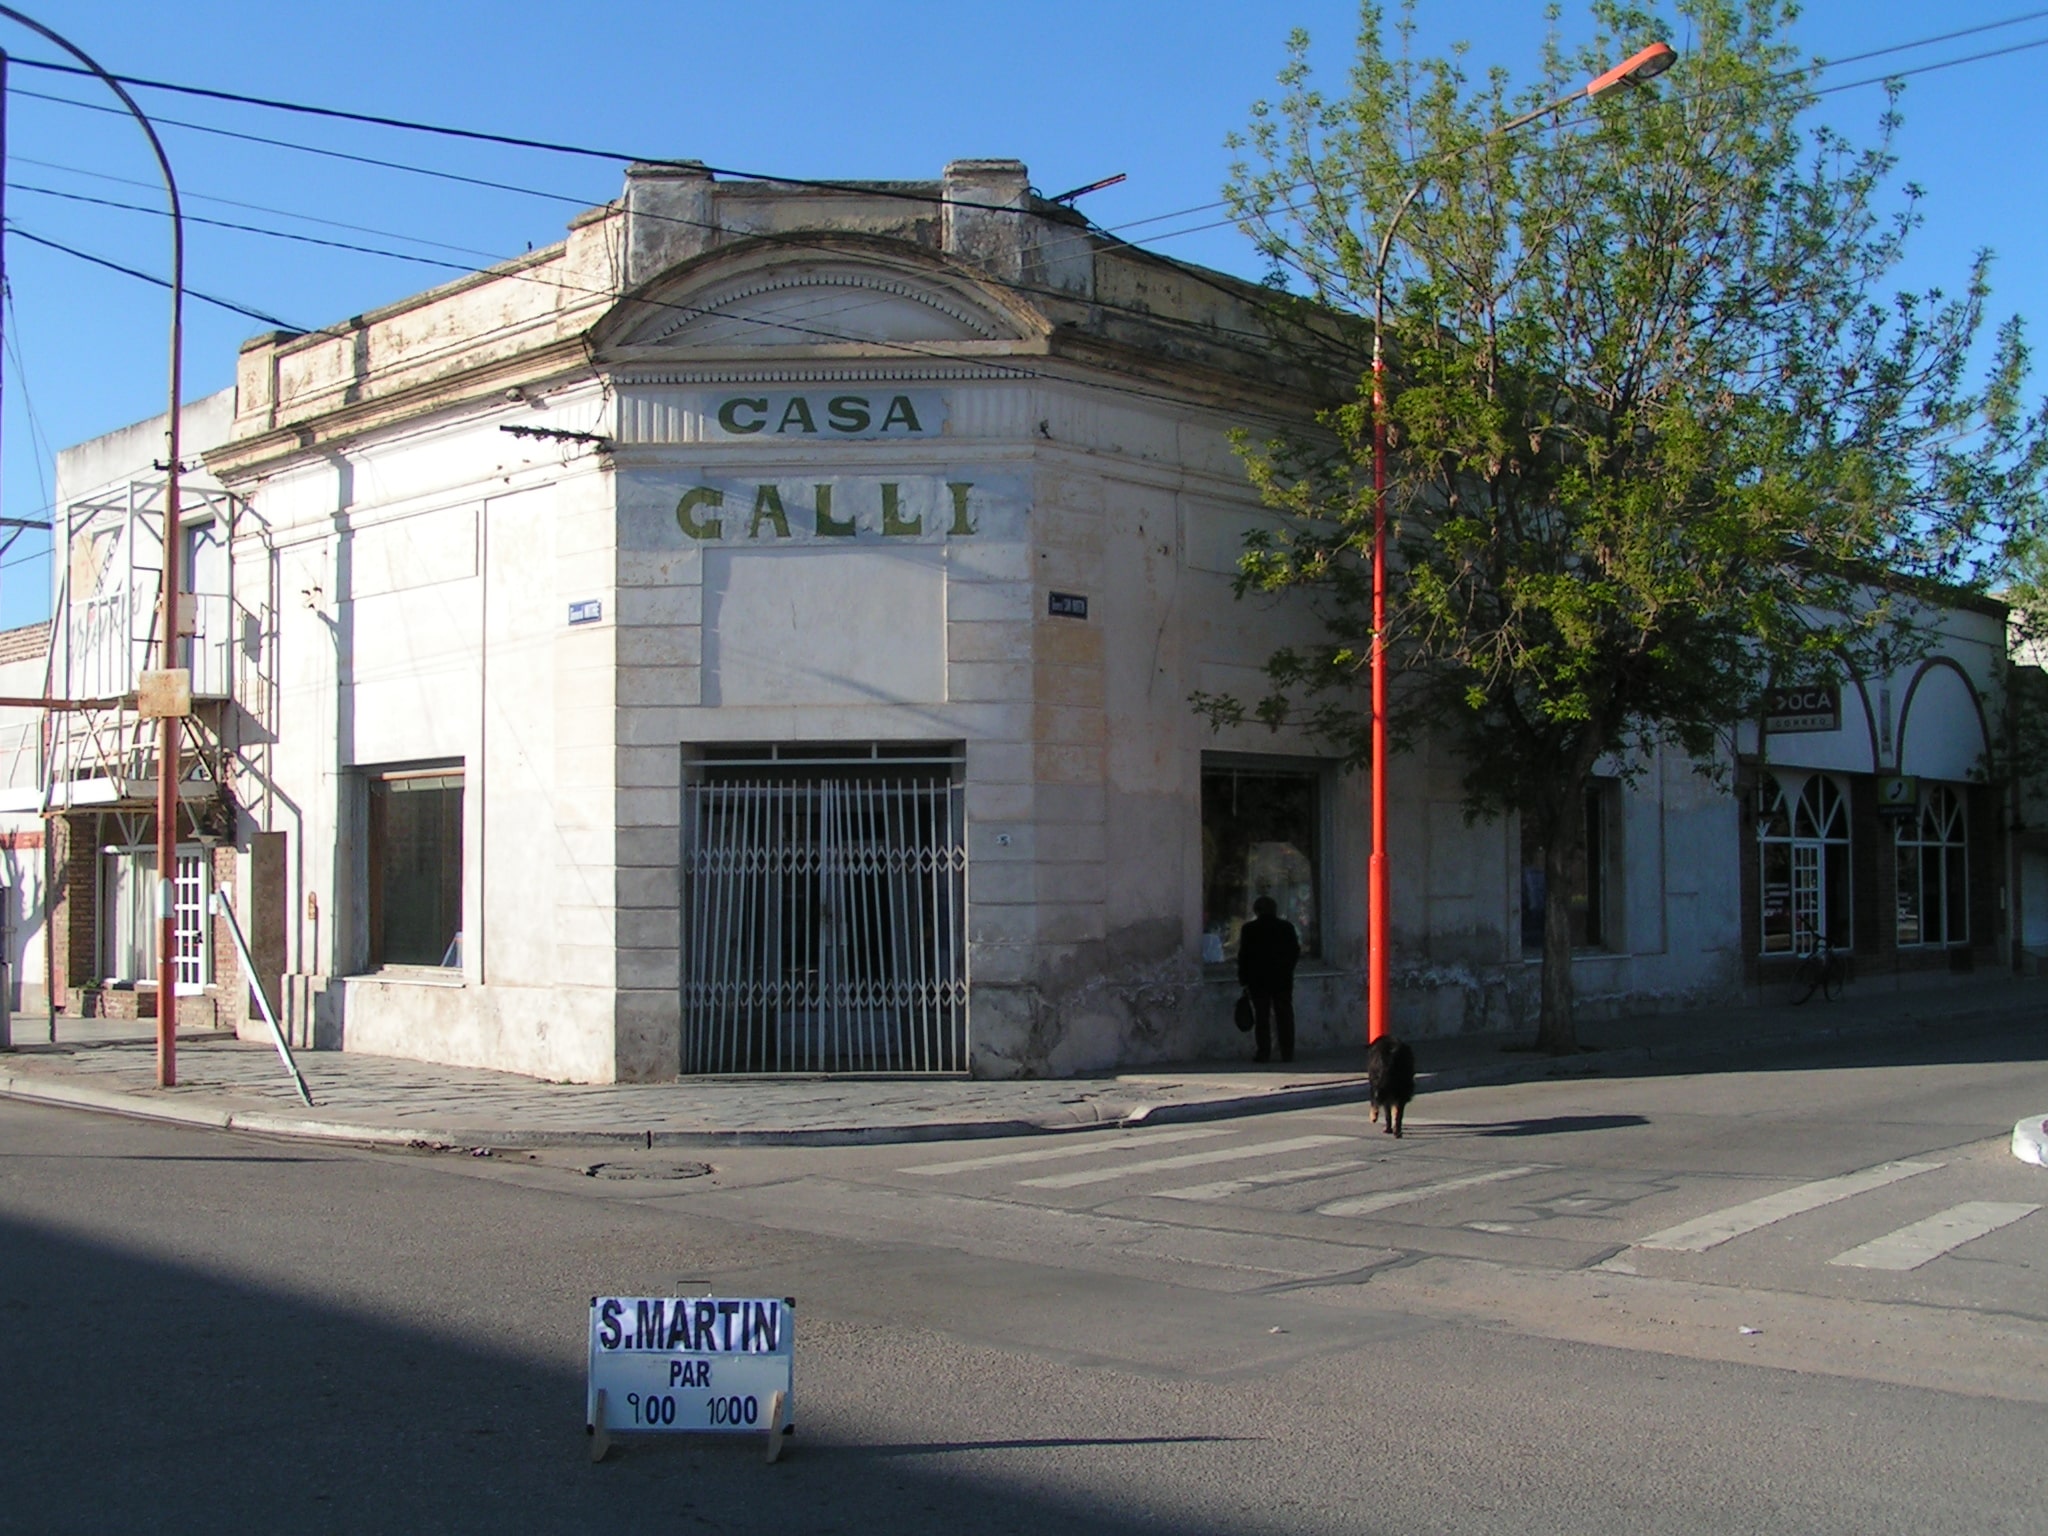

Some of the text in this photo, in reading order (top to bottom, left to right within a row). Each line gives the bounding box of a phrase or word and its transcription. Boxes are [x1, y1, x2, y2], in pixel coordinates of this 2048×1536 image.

[718, 395, 922, 434] CASA
[1788, 692, 1832, 710] OCA
[600, 1299, 778, 1351] S.MARTIN
[669, 1360, 711, 1388] PAR
[706, 1395, 758, 1425] 1000
